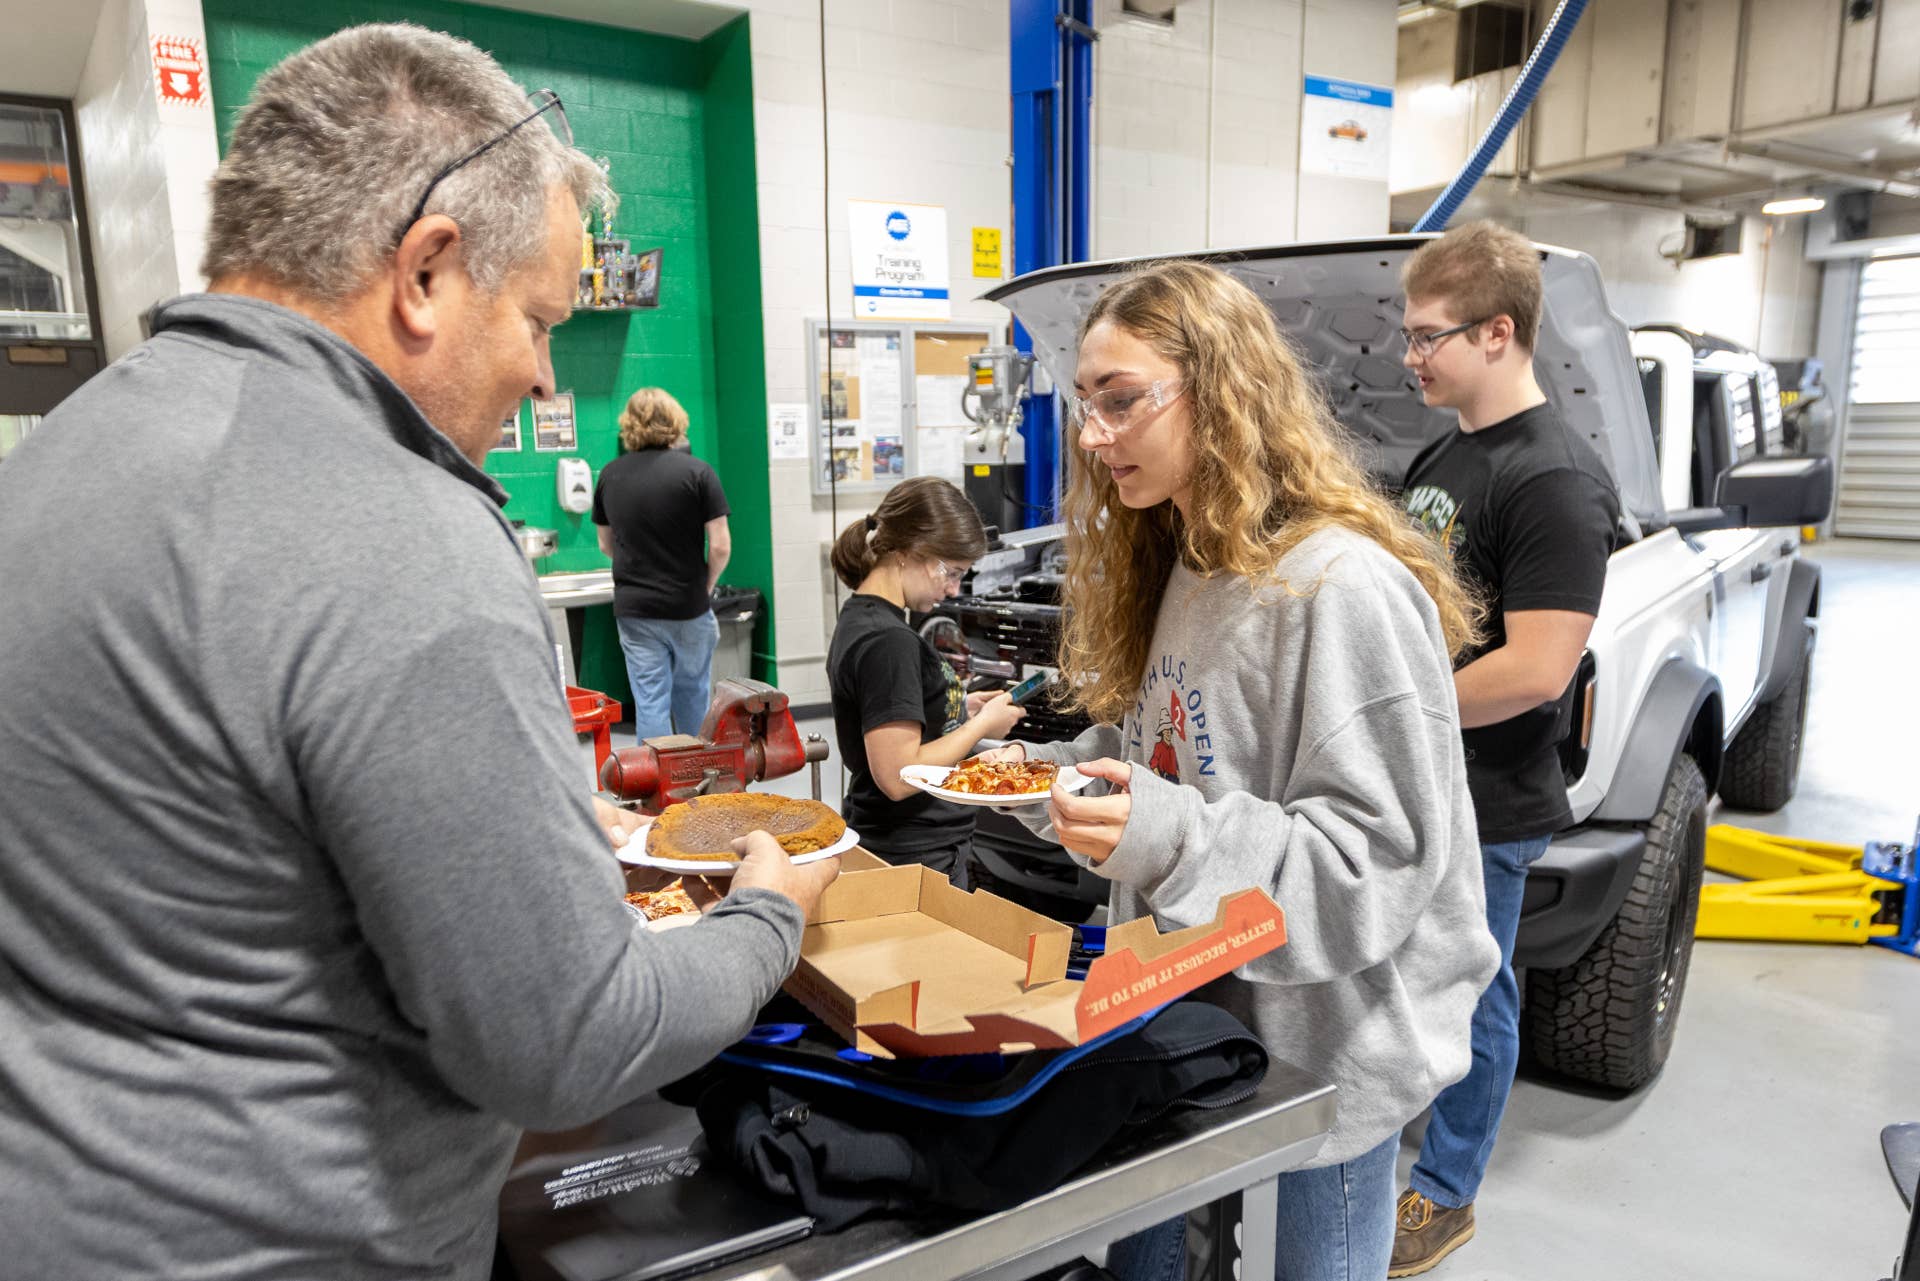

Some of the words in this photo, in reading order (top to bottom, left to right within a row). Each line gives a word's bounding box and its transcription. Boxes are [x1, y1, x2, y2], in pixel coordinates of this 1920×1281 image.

[158, 43, 194, 60] FIRE
[876, 254, 922, 272] Training
[875, 266, 925, 284] Program
[1162, 655, 1186, 690] U.S.
[1187, 689, 1216, 776] OPEN
[1228, 918, 1276, 948] BETTER,
[1174, 942, 1228, 972] BECAUSE
[1159, 968, 1173, 980] IT
[1131, 975, 1158, 996] HAS
[1085, 998, 1110, 1017] BE.
[1111, 991, 1131, 1006] TO
